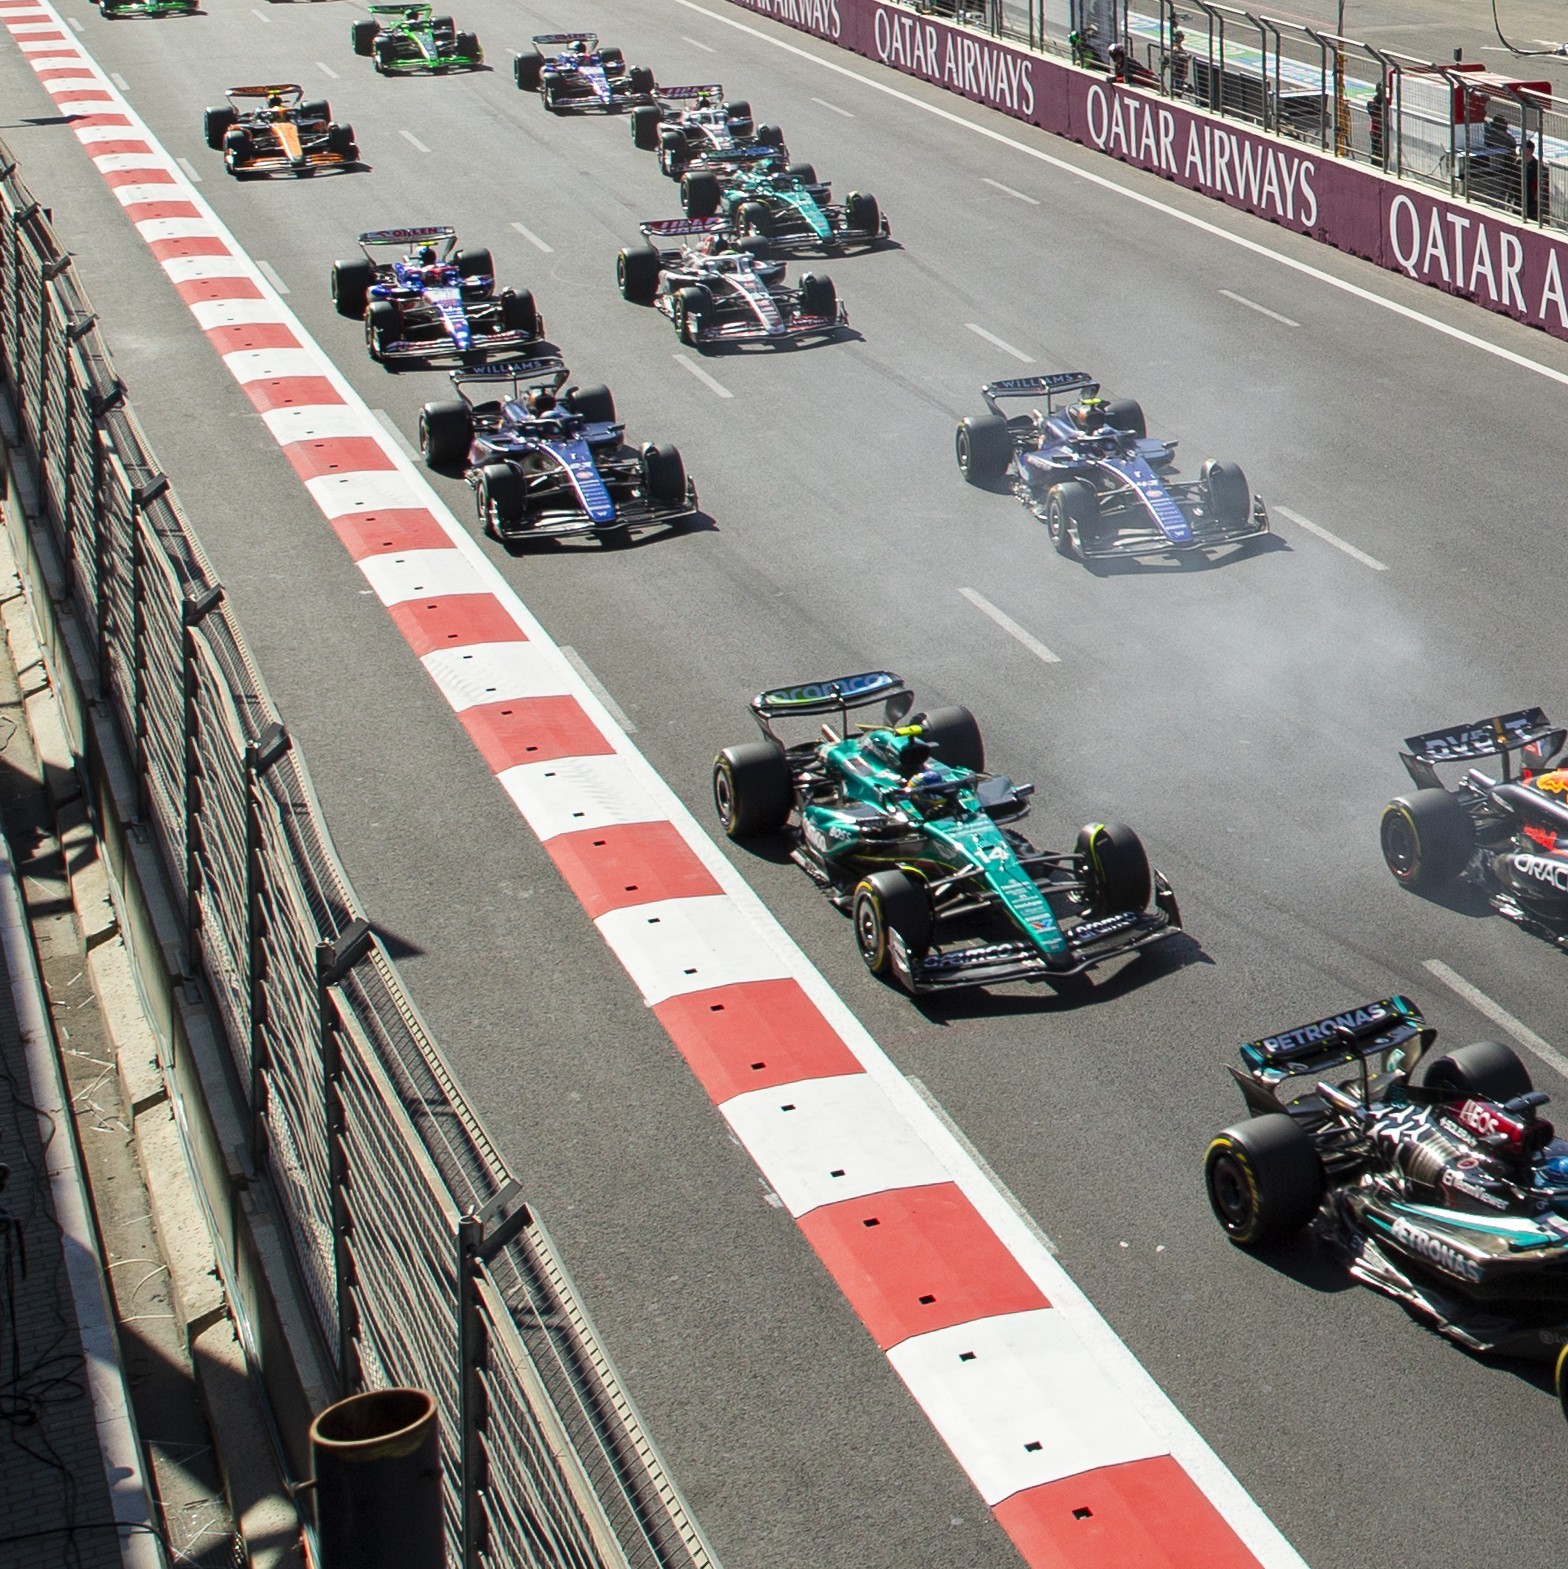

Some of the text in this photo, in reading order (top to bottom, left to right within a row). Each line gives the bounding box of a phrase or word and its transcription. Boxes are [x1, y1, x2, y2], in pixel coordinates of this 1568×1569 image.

[874, 8, 1034, 116] QATAR AIRWAYS
[1087, 84, 1318, 228] QATAR AIRWAYS
[1388, 194, 1527, 314] QATAR
[472, 359, 542, 375] WILLIAMS
[1001, 372, 1075, 390] WILLAMS
[973, 846, 1011, 865] 14
[1262, 1002, 1389, 1054] PETRONAS
[1391, 1216, 1483, 1284] PETRONAS
